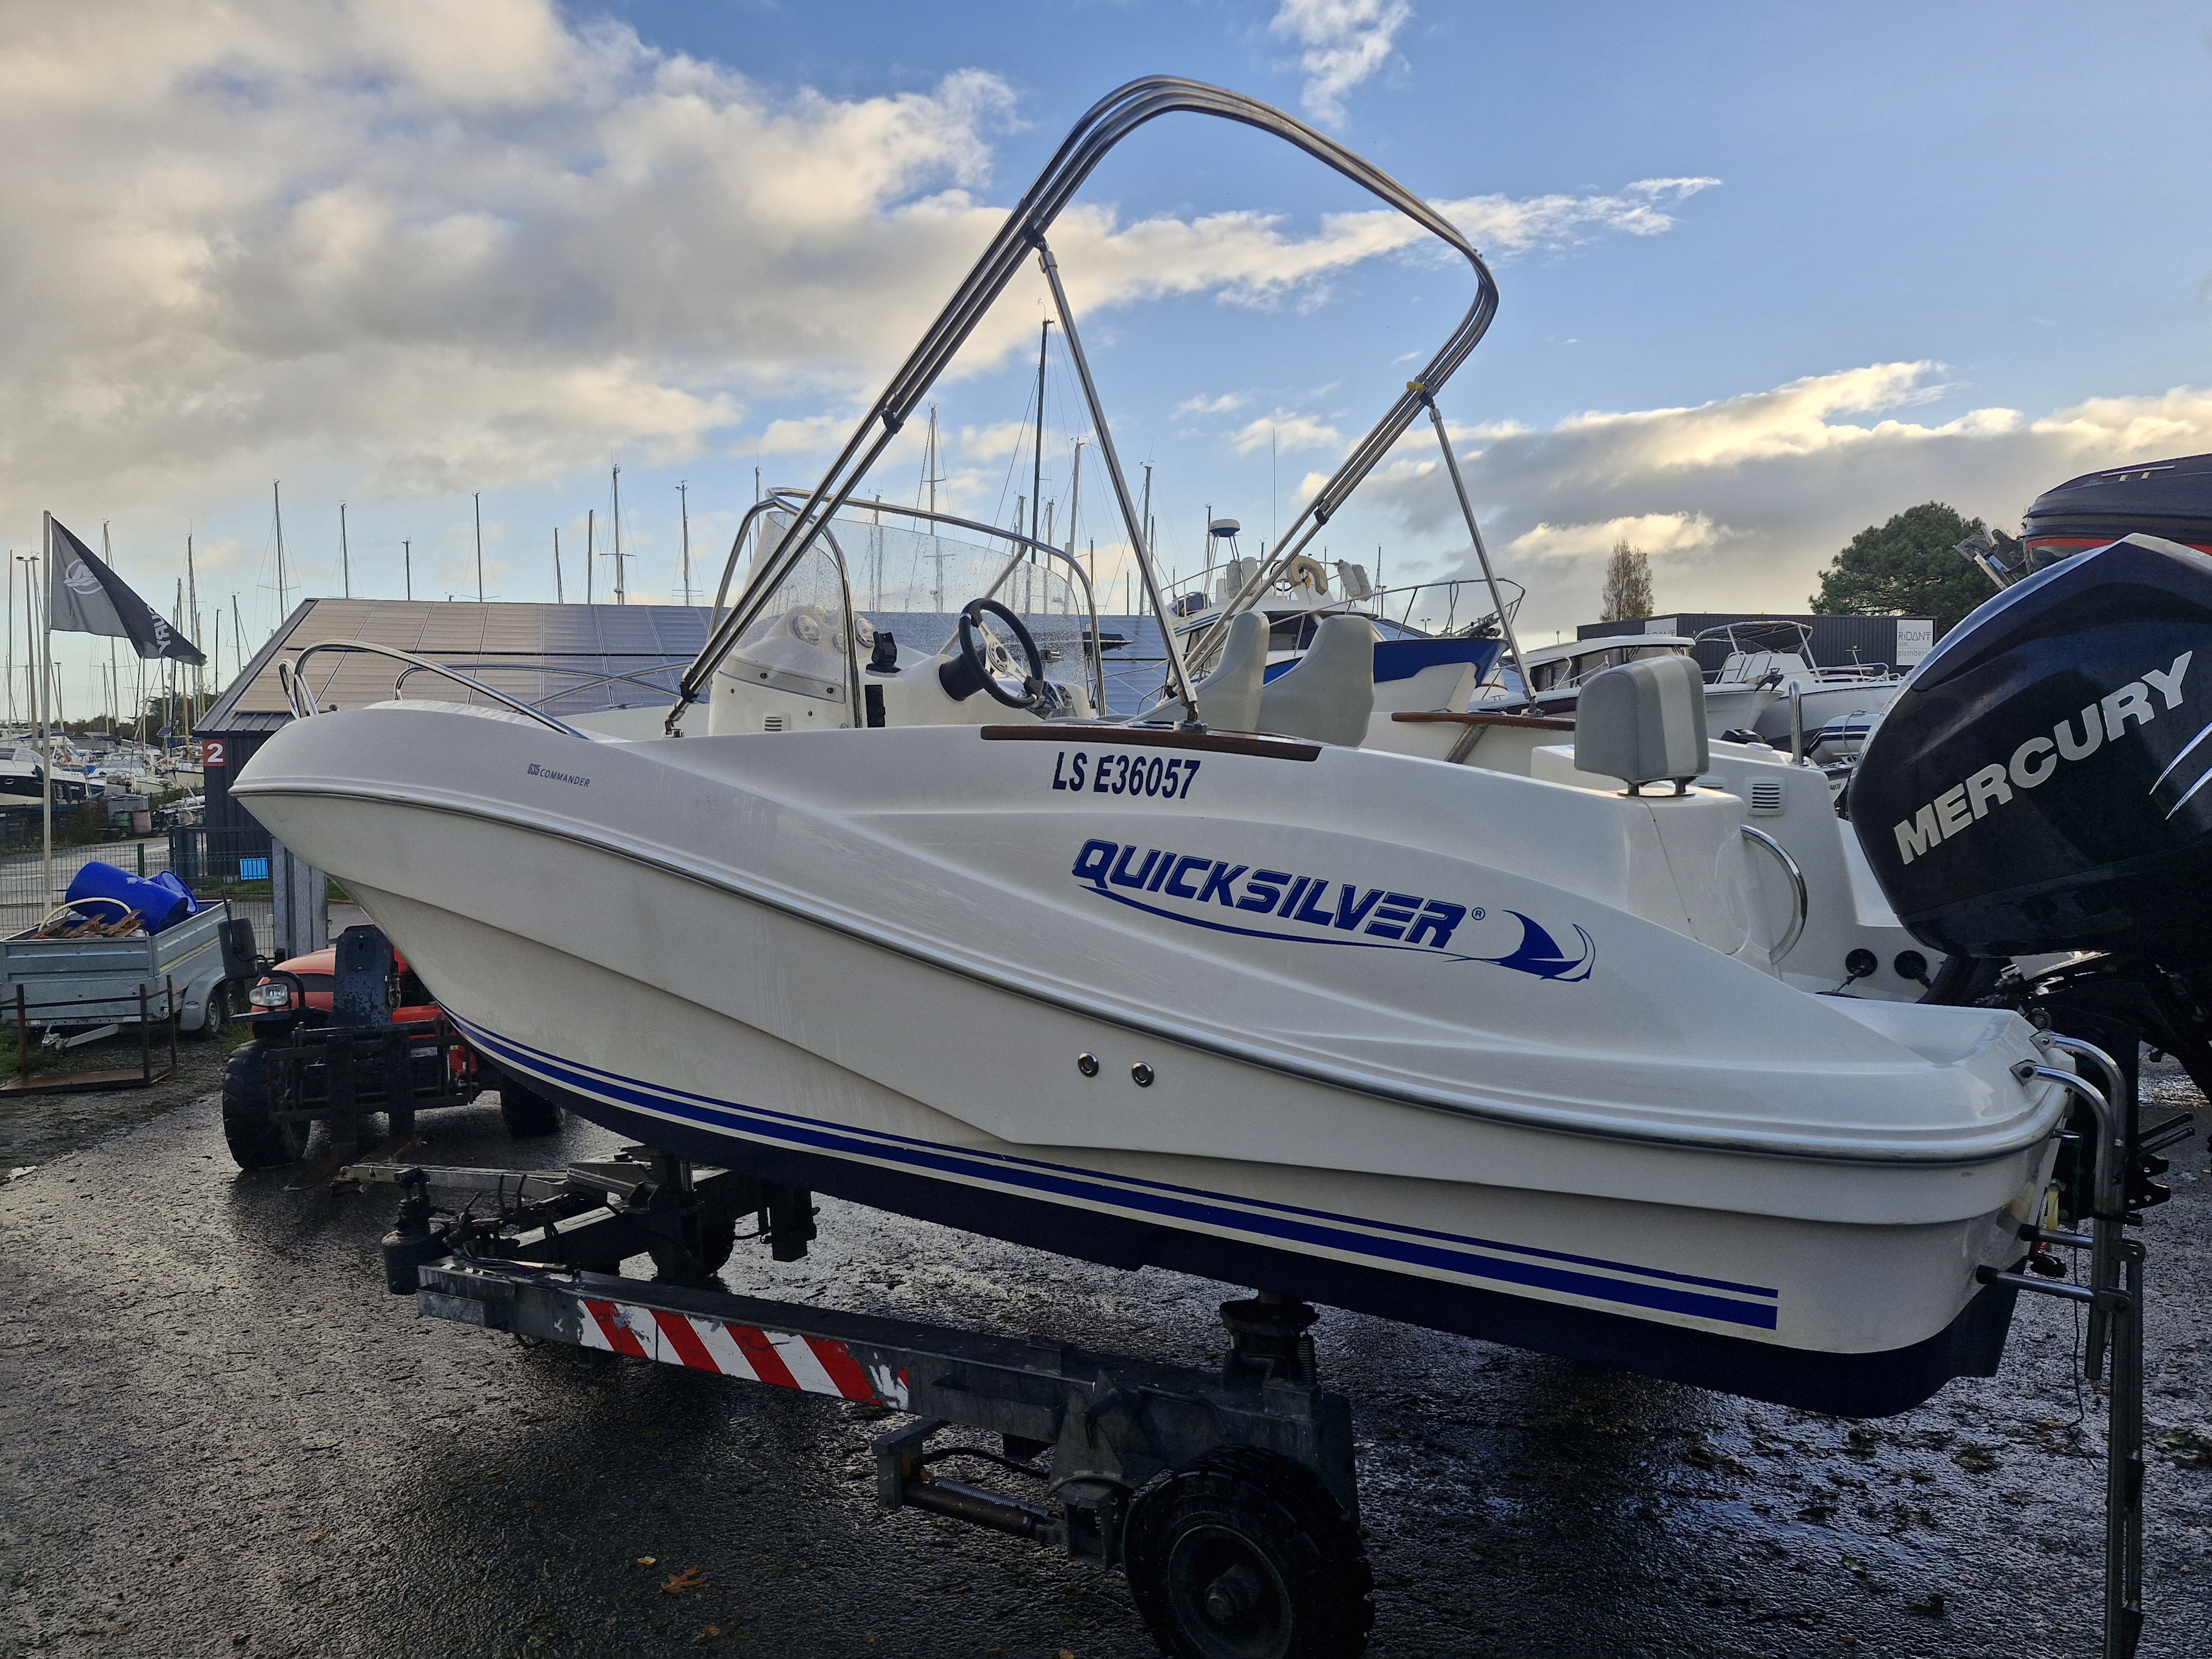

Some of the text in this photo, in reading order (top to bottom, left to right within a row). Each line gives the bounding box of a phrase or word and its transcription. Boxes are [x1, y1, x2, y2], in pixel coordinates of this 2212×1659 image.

[207, 743, 223, 763] 2
[527, 763, 590, 788] 635 COMMANDER
[1052, 752, 1201, 799] LS E36057
[1893, 650, 2193, 865] MERCURY
[1071, 838, 1467, 950] QUICKSILVER
